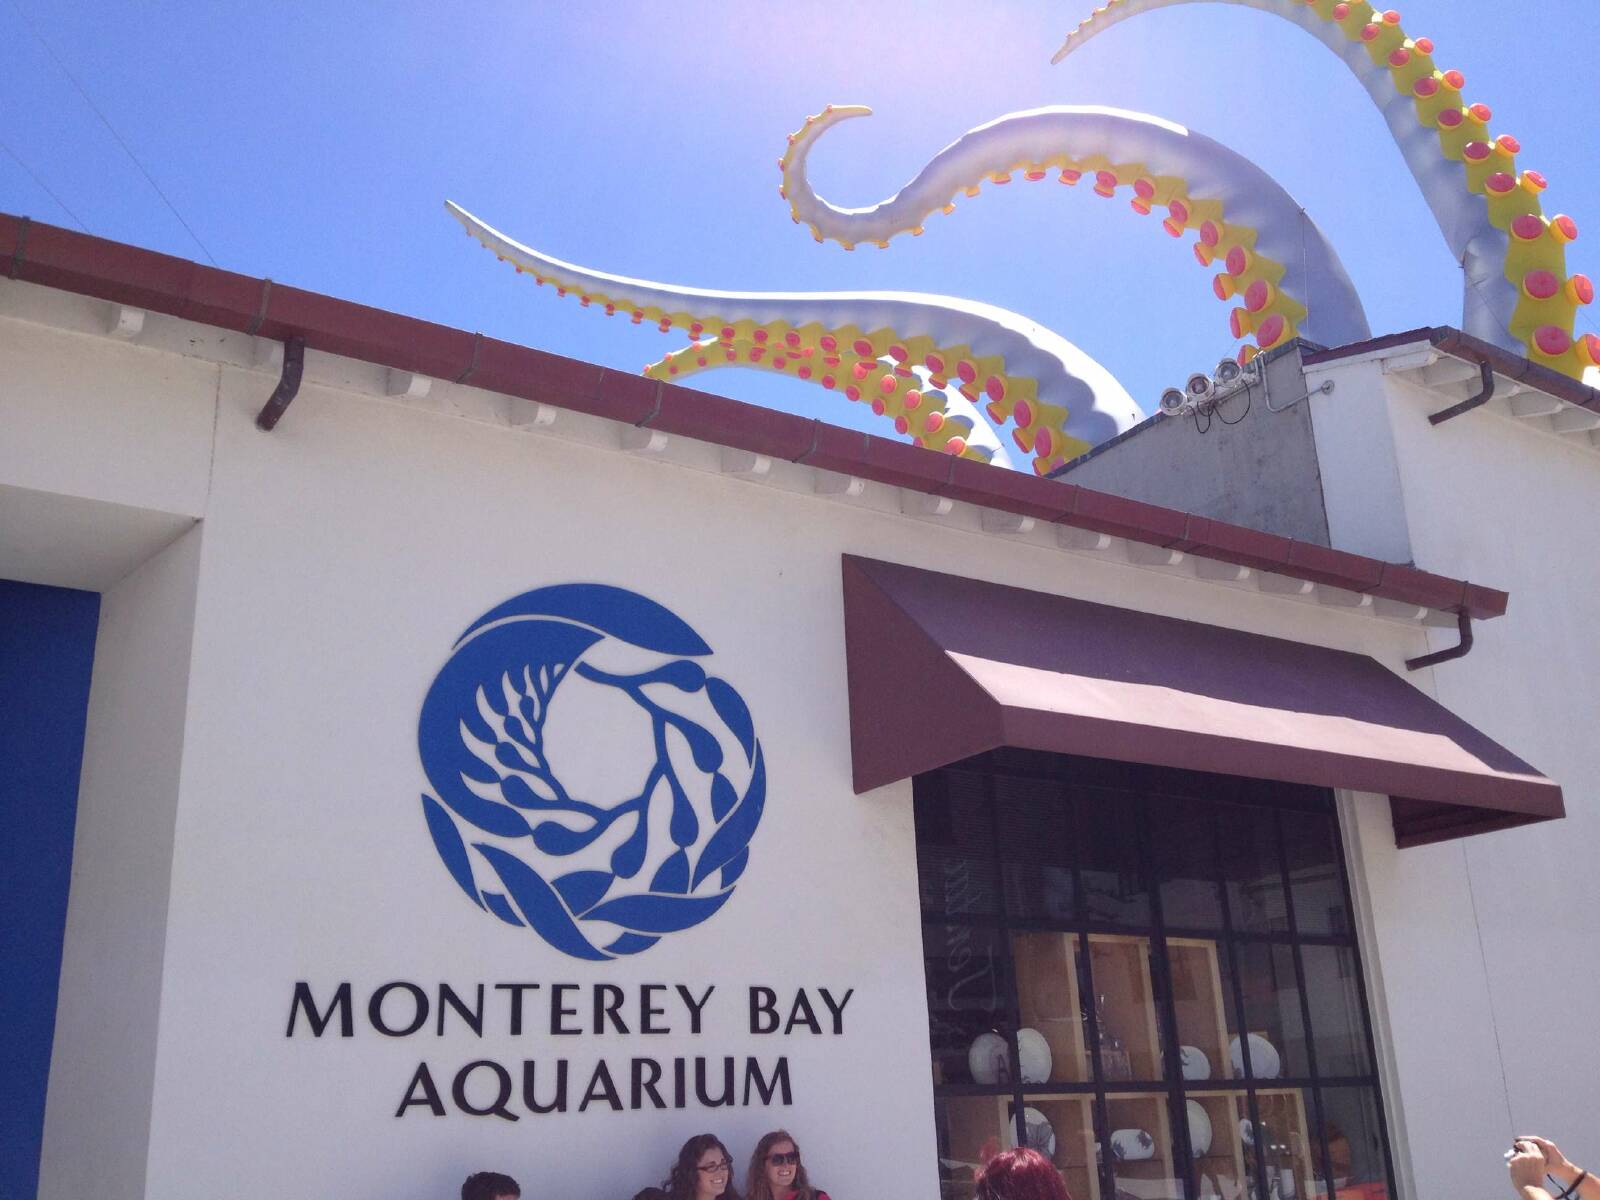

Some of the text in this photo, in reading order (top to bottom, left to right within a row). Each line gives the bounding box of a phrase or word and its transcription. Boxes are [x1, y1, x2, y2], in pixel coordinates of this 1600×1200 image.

[286, 982, 855, 1038] MONTEREY BAY
[395, 1057, 793, 1122] AQUARIUM
